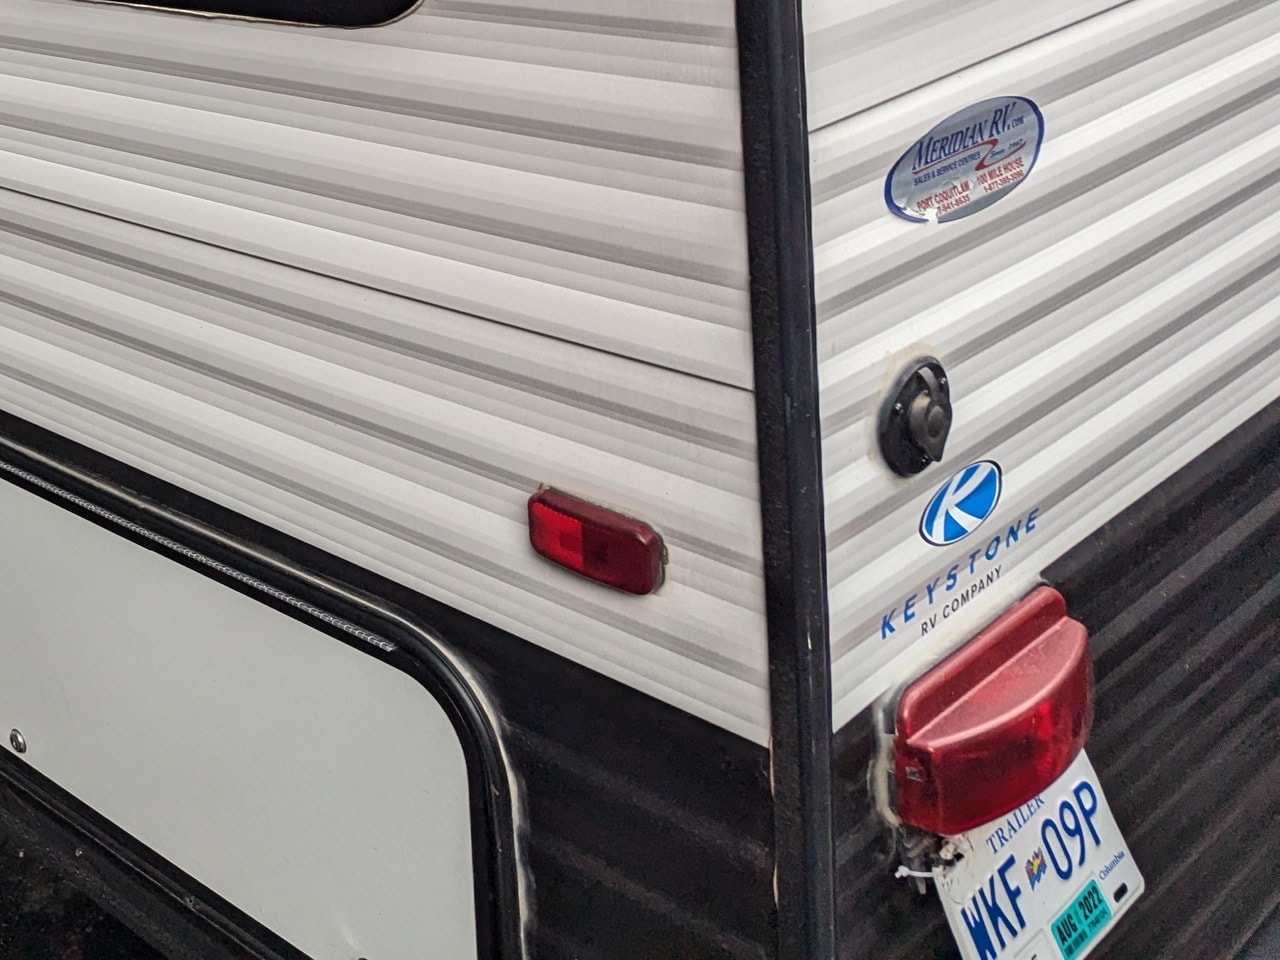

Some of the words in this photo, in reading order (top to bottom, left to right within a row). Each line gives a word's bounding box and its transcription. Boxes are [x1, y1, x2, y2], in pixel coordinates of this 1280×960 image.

[913, 172, 932, 186] SALES
[936, 161, 958, 177] SERVICE
[916, 195, 934, 212] PORT
[934, 181, 970, 205] COQUITLAM
[987, 164, 1004, 182] MILE
[1003, 157, 1025, 176] HOUSE
[880, 507, 1040, 640] KEYSTONE
[921, 613, 937, 637] RV
[942, 564, 1002, 619] COMPANY
[985, 795, 1045, 855] TRAILER
[960, 854, 1026, 960] WKF
[1040, 780, 1102, 881] 09P
[1098, 850, 1126, 881] Columbia
[1056, 913, 1078, 946] AUG
[1078, 885, 1104, 921] 2022
